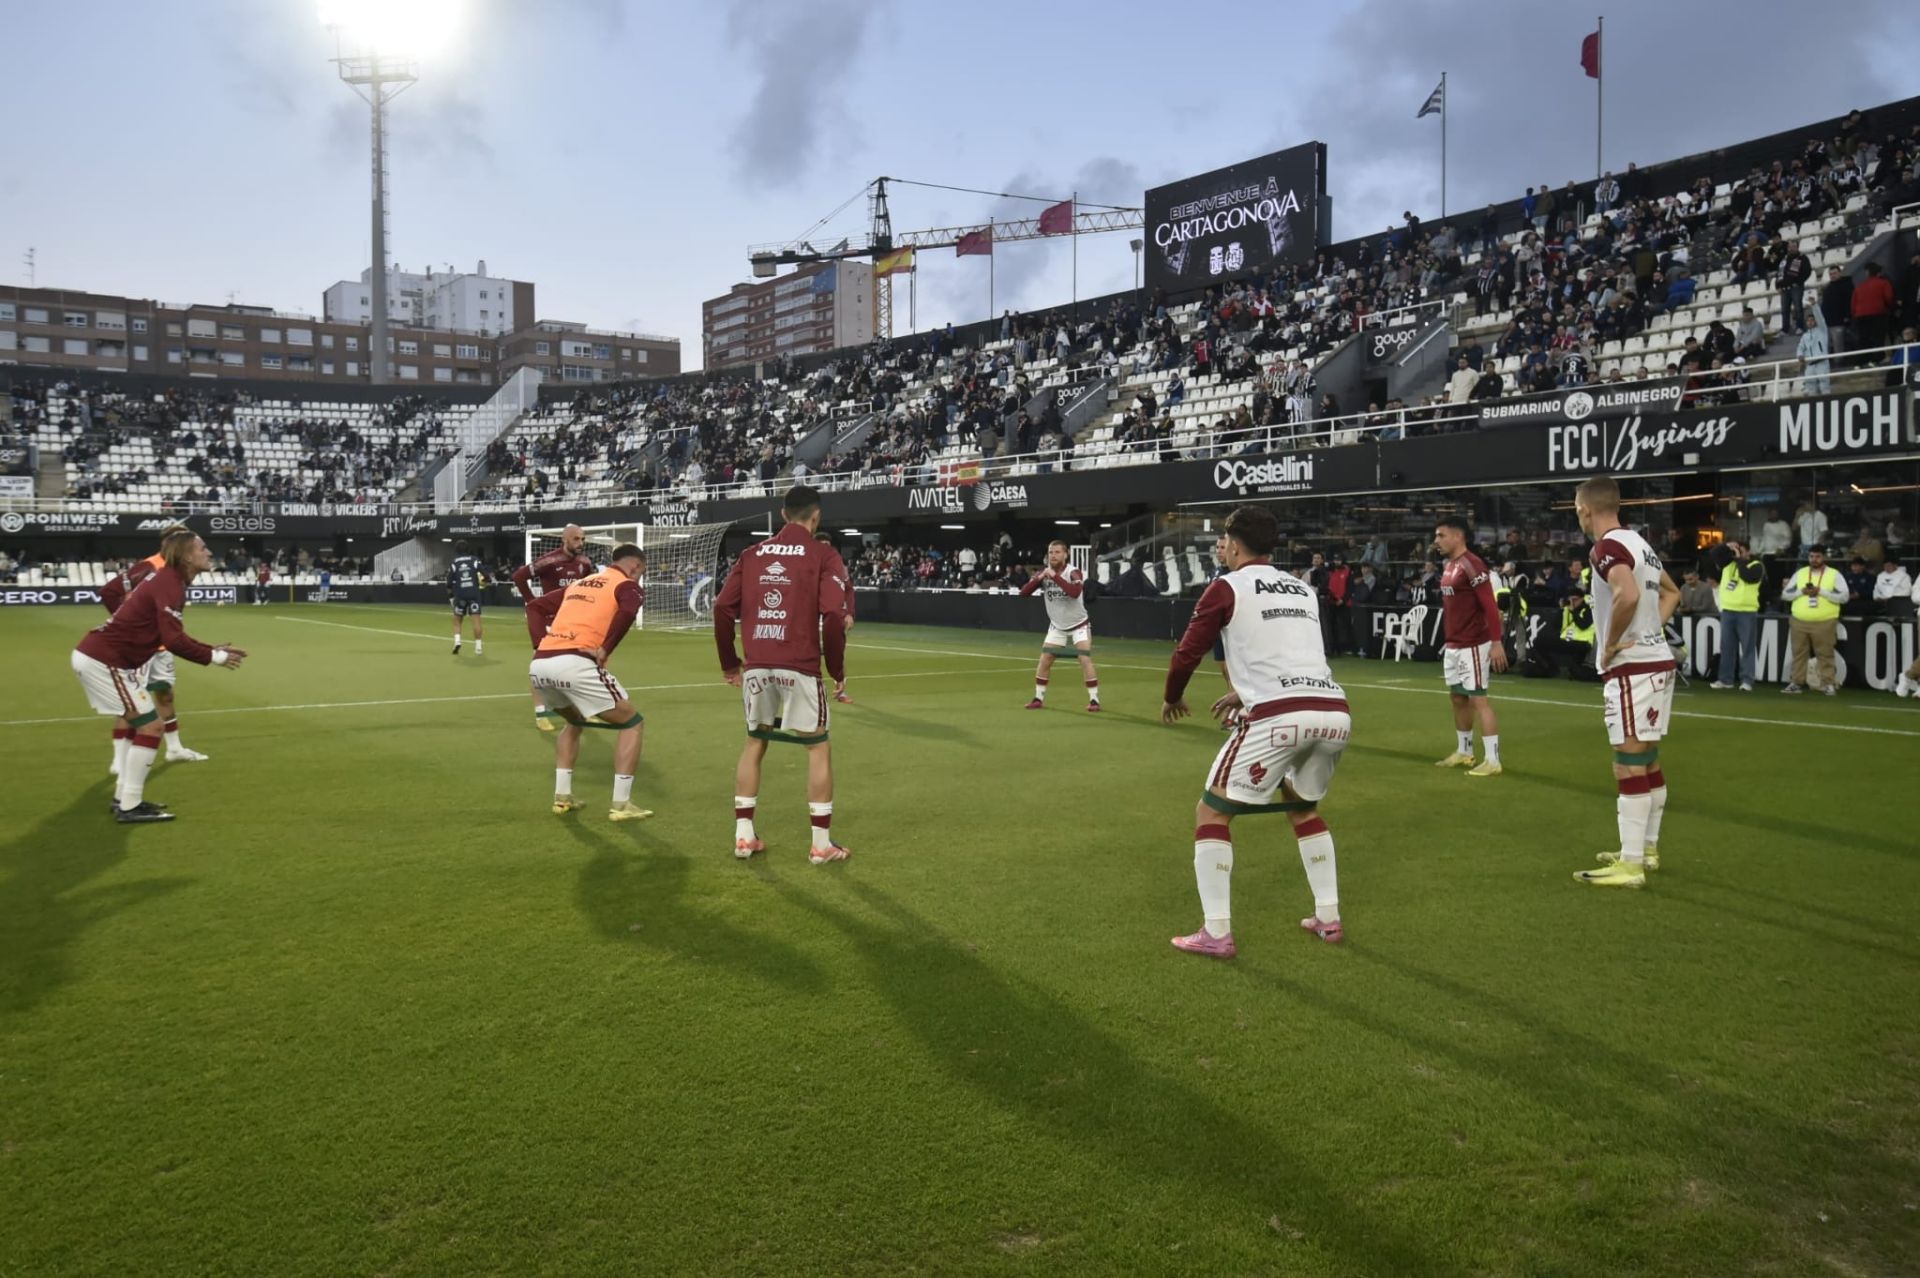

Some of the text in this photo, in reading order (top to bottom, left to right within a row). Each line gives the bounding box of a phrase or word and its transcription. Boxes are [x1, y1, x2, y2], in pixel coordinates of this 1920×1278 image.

[1170, 184, 1260, 220] BIENVENUE
[1155, 189, 1301, 247] CARTAGONOVA
[1482, 385, 1681, 419] SUBMARINO ALBINEGRO
[1549, 416, 1737, 471] FCC Business
[1232, 454, 1313, 486] Castellini
[907, 487, 964, 508] AVATEL
[991, 485, 1028, 500] CAESA
[281, 504, 378, 516] CURVA VICKERS
[649, 503, 688, 514] MUDANZAS
[25, 513, 120, 525] RONIWESK
[210, 516, 276, 530] estels
[653, 514, 685, 527] MOFLY
